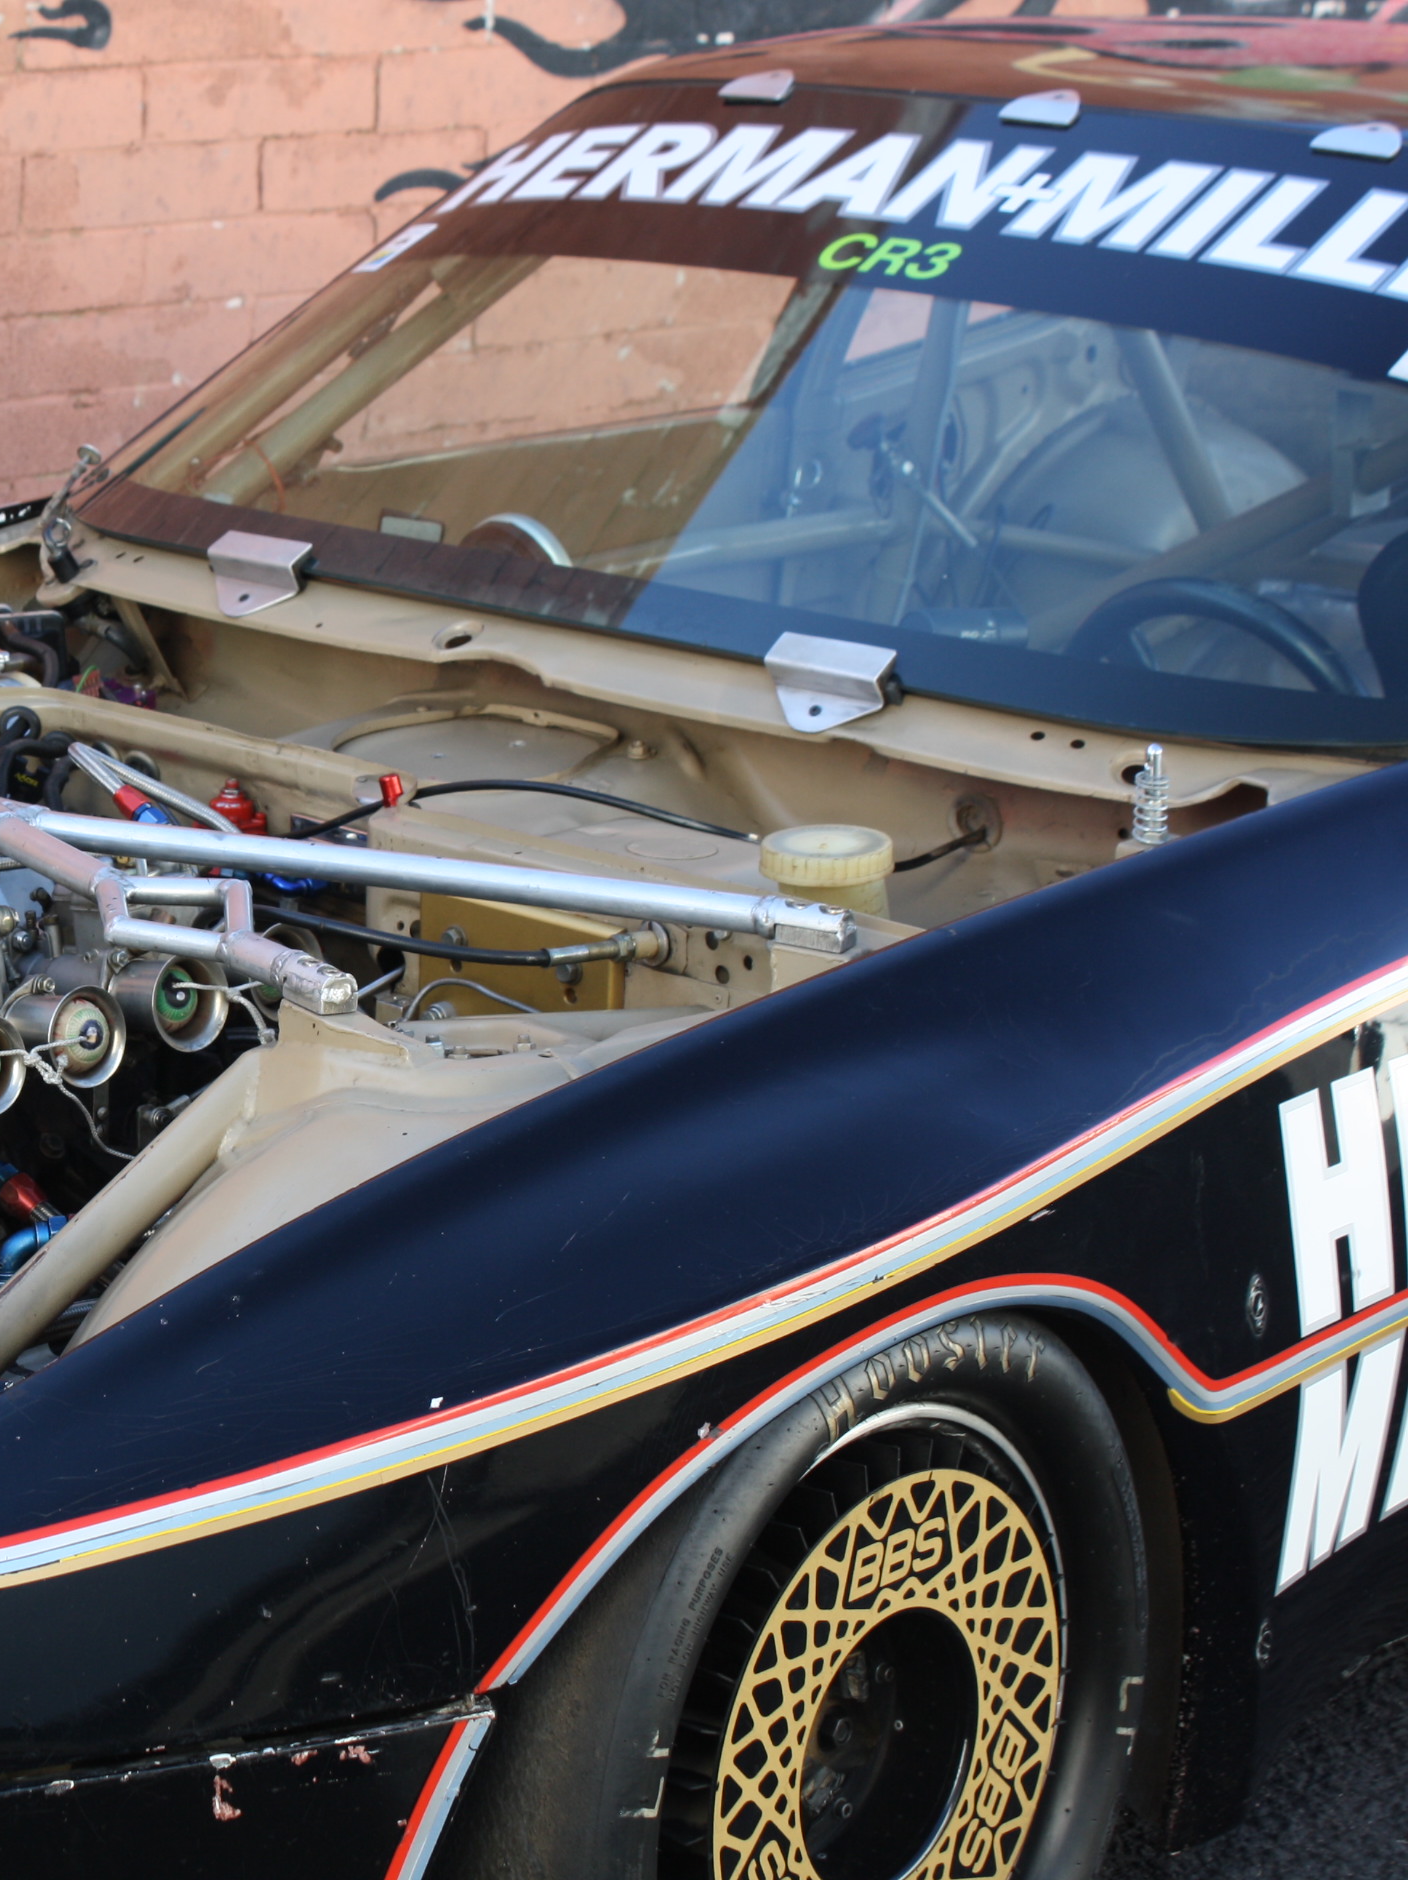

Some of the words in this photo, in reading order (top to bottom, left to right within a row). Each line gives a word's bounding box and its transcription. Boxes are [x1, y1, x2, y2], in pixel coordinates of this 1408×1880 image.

[818, 233, 962, 280] CR3
[999, 148, 1408, 303] MILL
[1279, 1052, 1408, 1338] H
[1273, 1327, 1408, 1597] M
[668, 1617, 691, 1665] RACING
[688, 1546, 724, 1612] PURPOSES
[848, 1516, 946, 1603] BBS
[958, 1718, 1027, 1874] BBS
